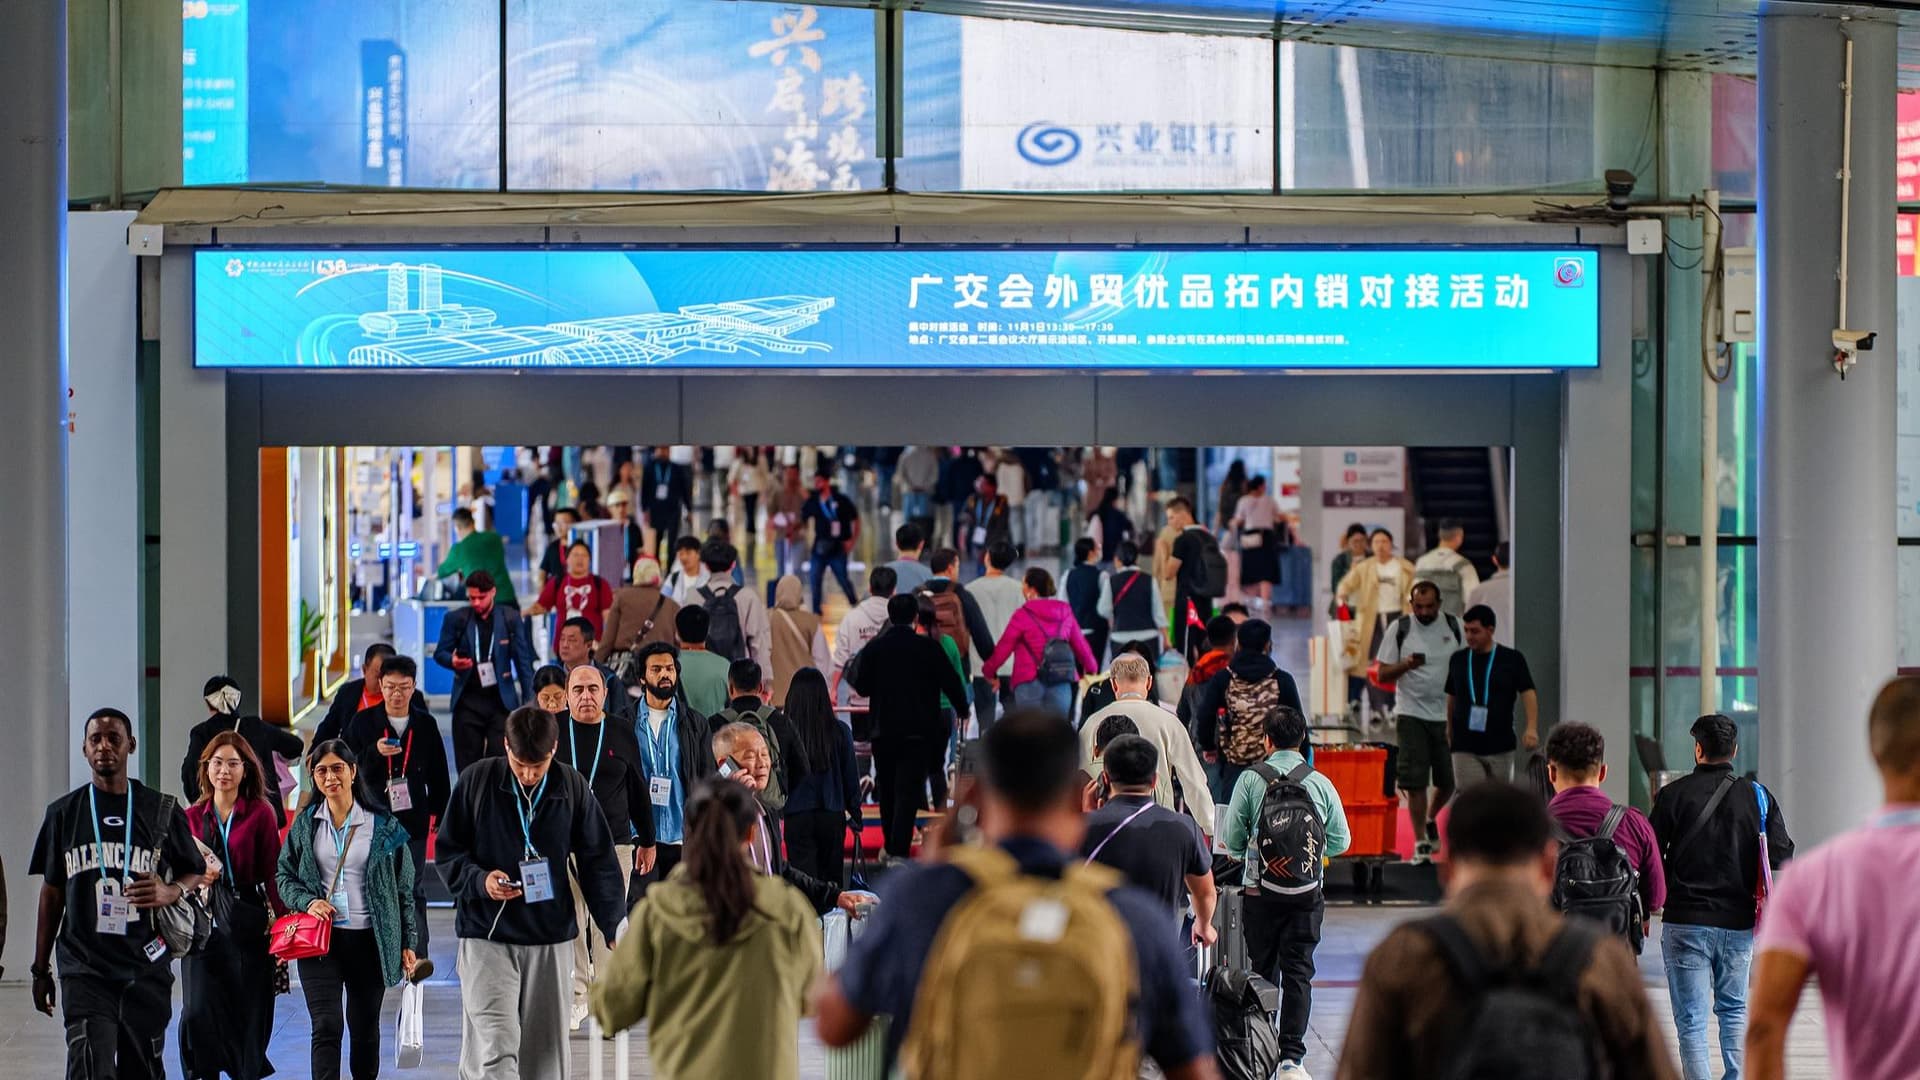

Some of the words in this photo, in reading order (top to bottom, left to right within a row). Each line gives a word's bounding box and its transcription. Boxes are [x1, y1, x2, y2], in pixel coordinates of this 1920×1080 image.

[1095, 121, 1237, 154] 兴业银行
[908, 273, 1530, 309] 广交会外贸优品拓内销对接活动
[65, 842, 154, 880] BALENCAG
